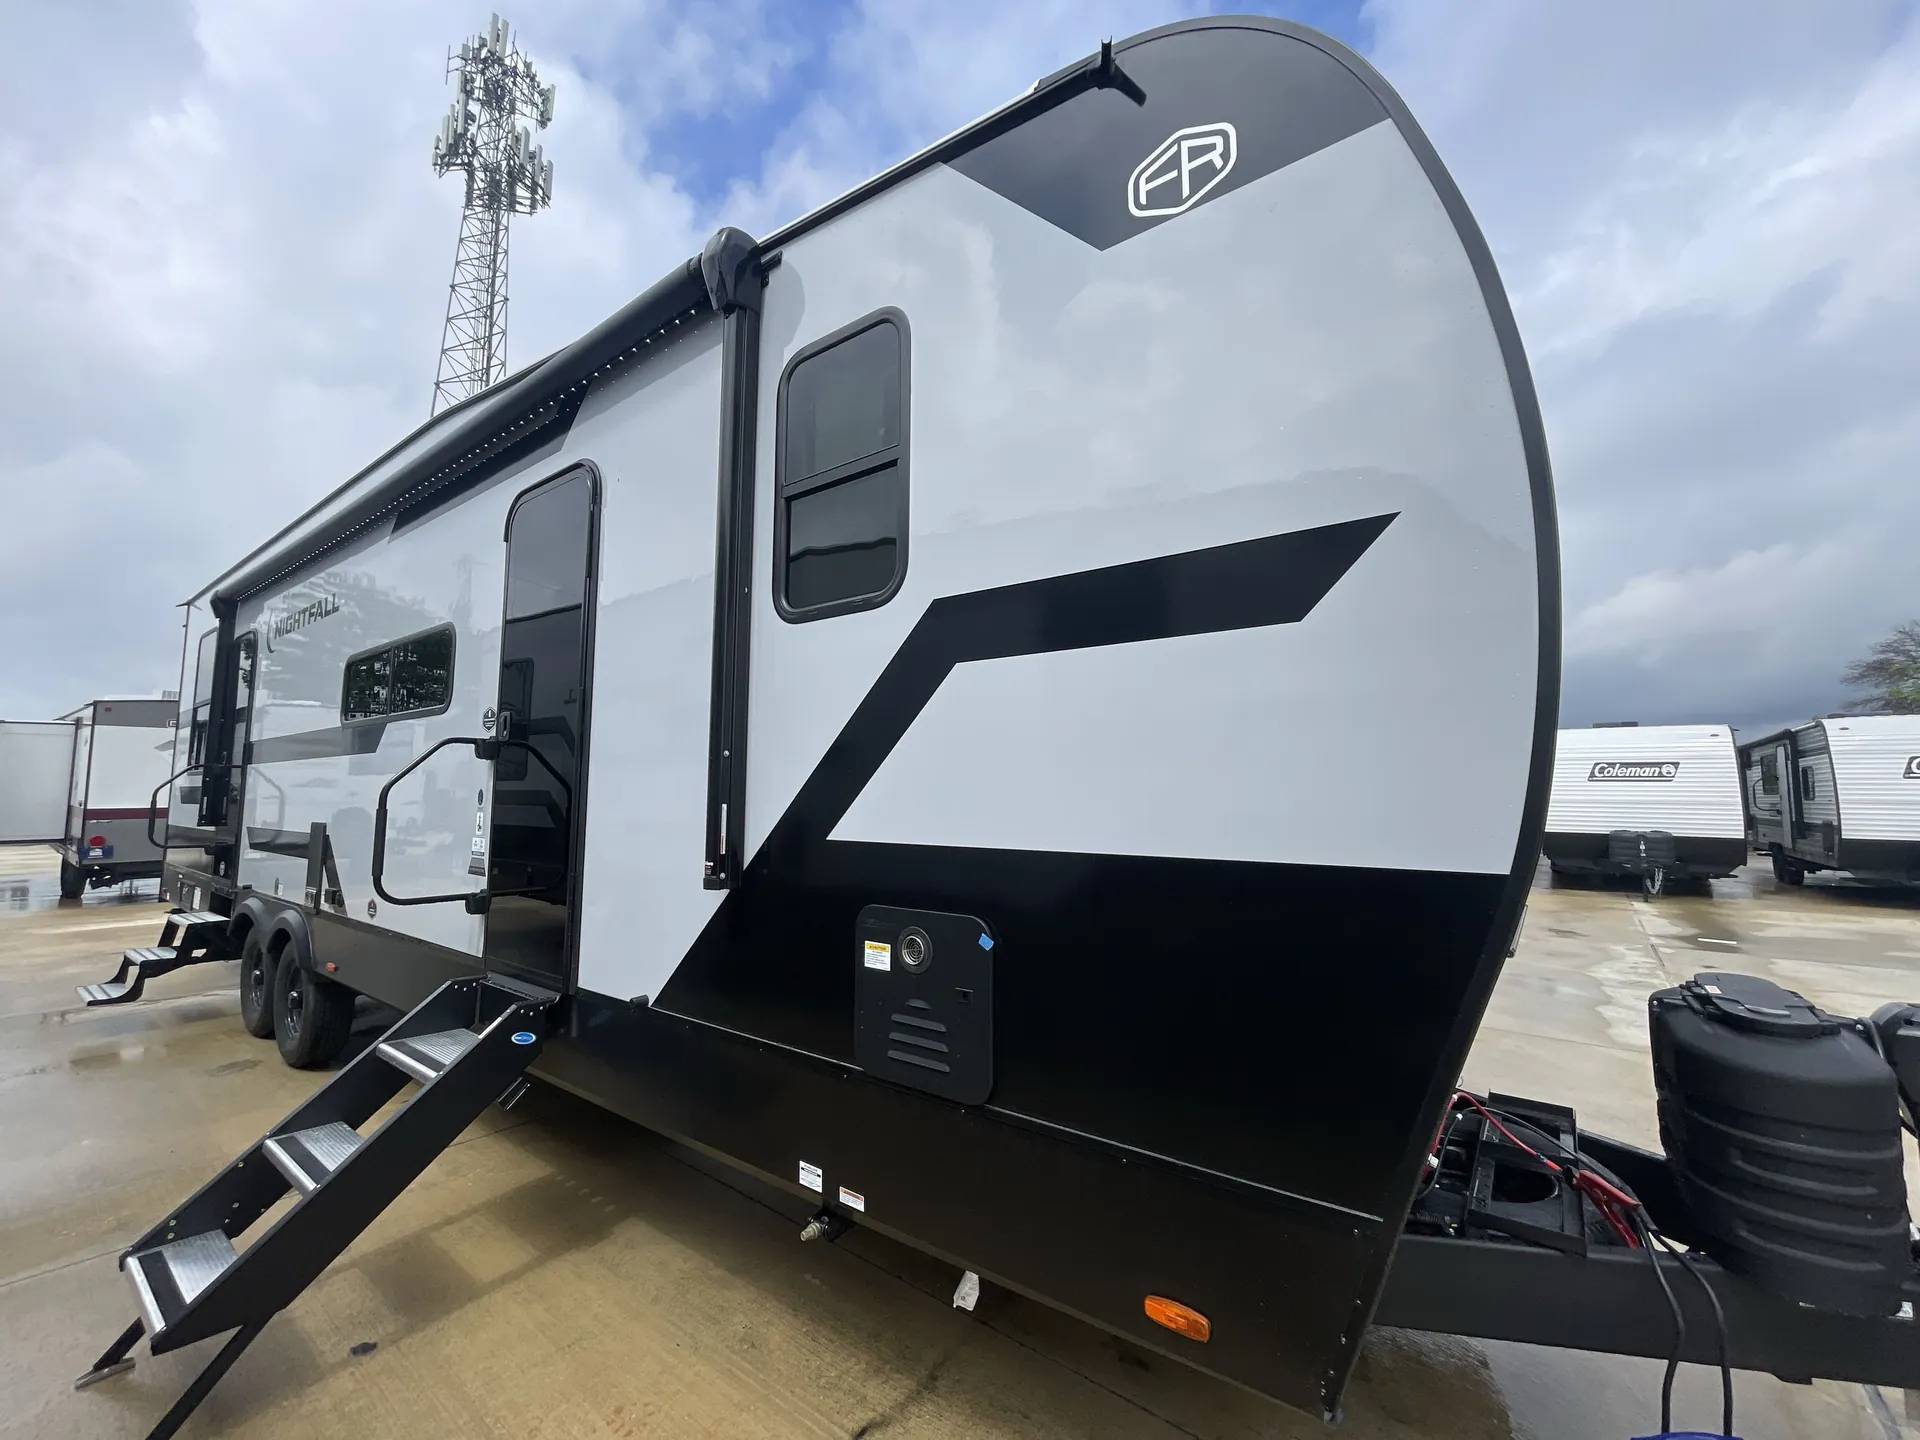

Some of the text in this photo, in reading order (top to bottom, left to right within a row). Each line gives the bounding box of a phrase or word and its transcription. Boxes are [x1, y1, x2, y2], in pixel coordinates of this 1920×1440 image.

[1139, 135, 1224, 205] FR
[274, 593, 340, 640] NIGHTFALL
[1594, 763, 1660, 777] Coleman
